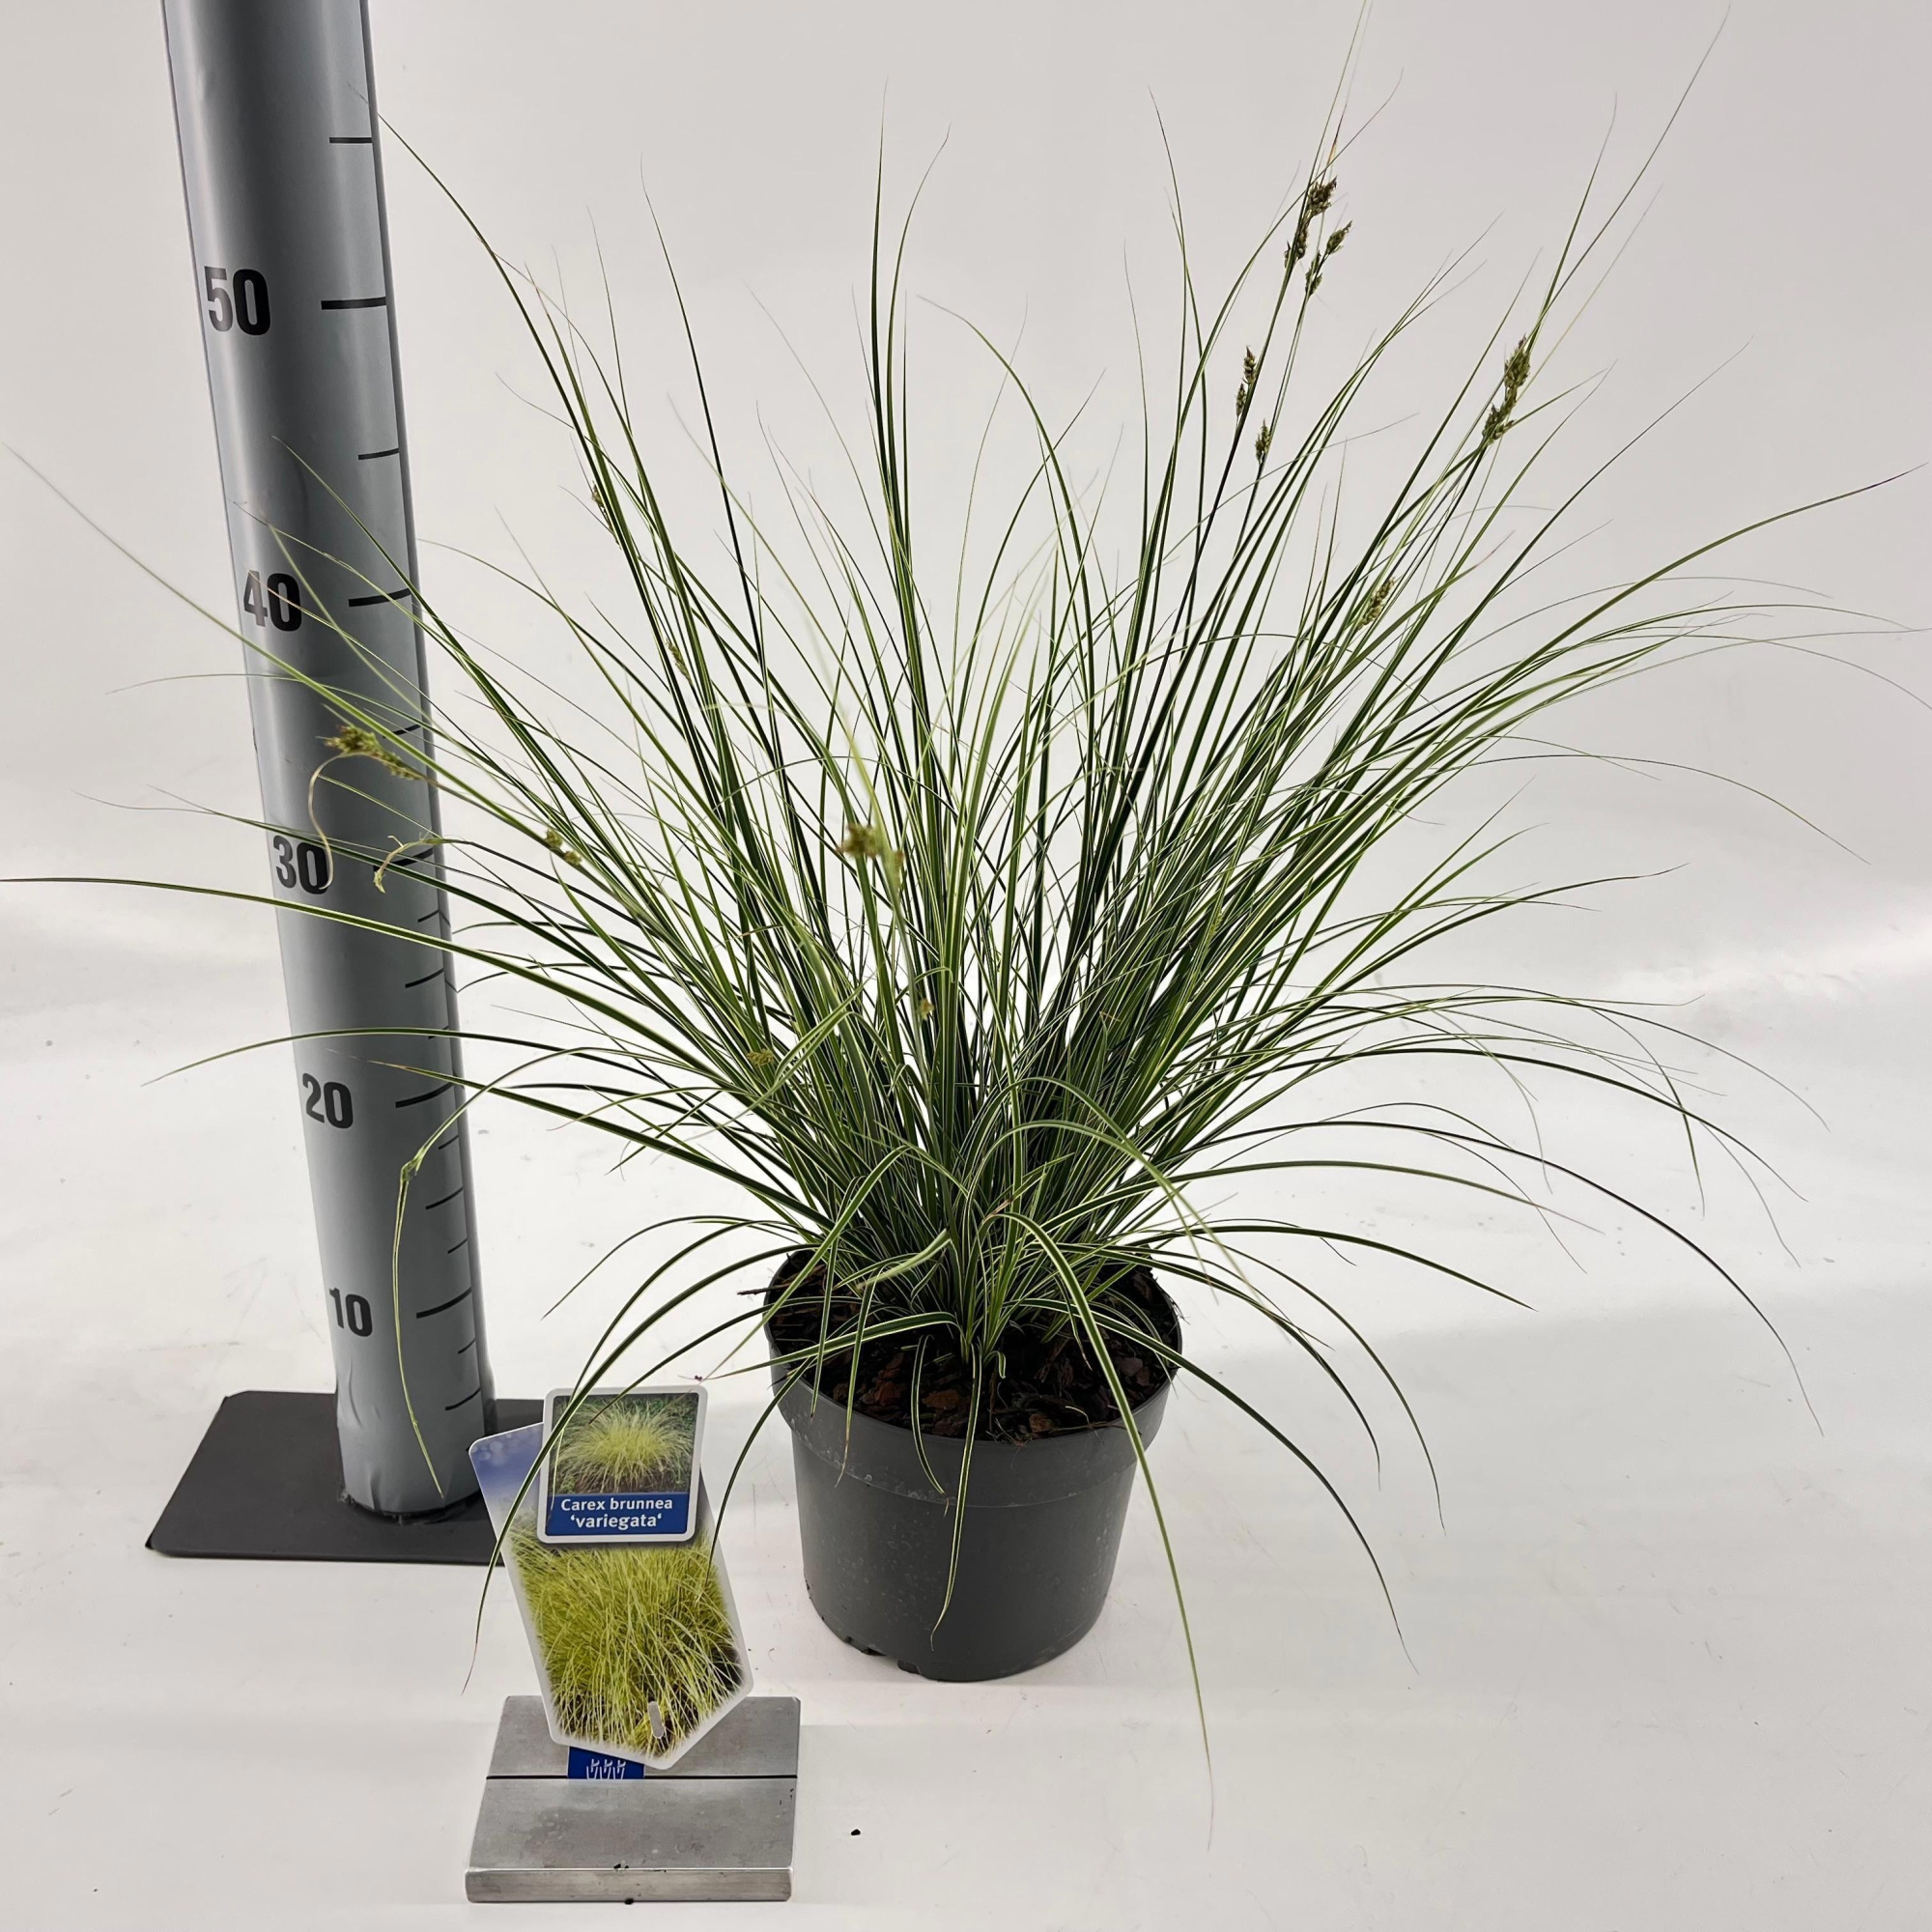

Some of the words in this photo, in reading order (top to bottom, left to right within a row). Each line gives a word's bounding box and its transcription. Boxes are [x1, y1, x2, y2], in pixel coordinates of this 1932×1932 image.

[204, 266, 270, 335] 50
[242, 570, 302, 632] 40
[273, 835, 332, 895] 30
[301, 1072, 354, 1129] 20
[328, 1287, 373, 1337] 10
[560, 1498, 606, 1512] Carex
[610, 1497, 673, 1511] brunnea
